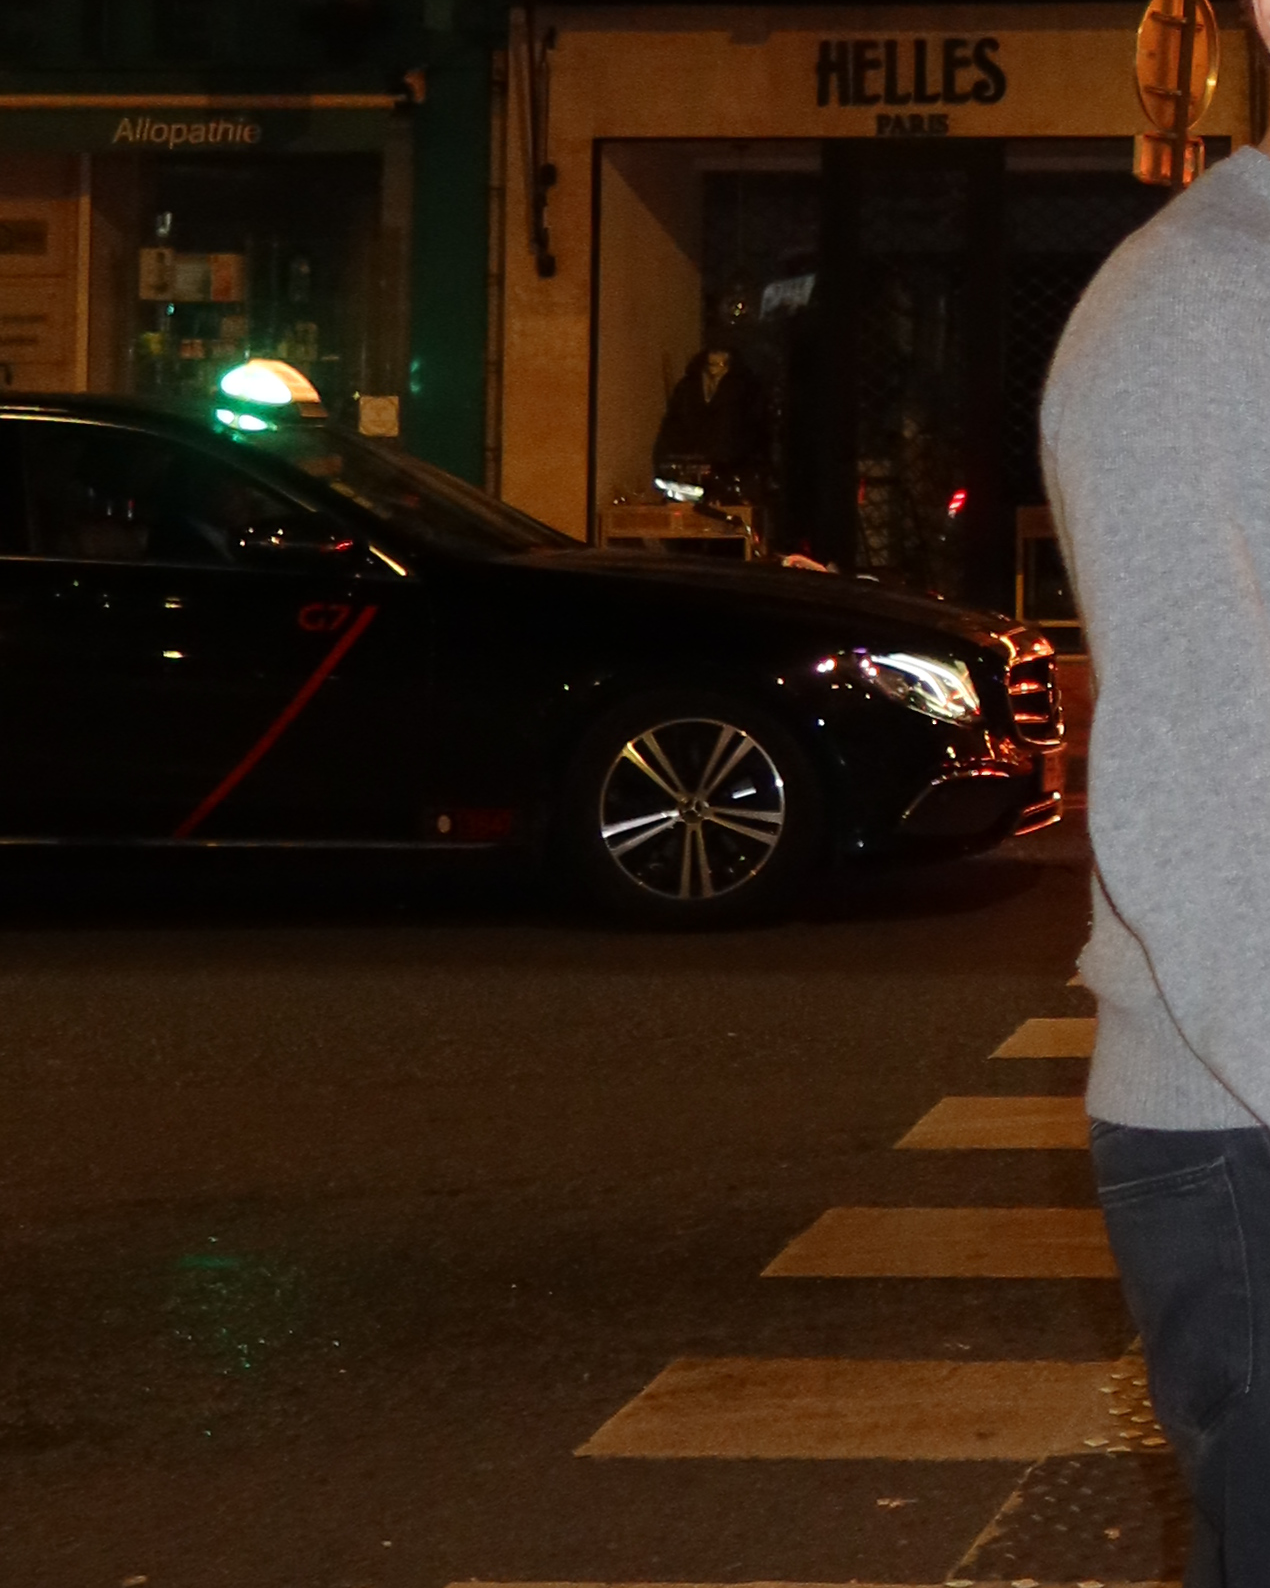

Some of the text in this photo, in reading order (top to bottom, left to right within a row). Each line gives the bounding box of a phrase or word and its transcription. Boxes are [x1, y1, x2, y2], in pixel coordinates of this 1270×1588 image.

[816, 37, 1006, 107] HELLES
[112, 117, 261, 150] Allopathie
[875, 114, 949, 136] PARIS
[297, 601, 352, 632] G7
